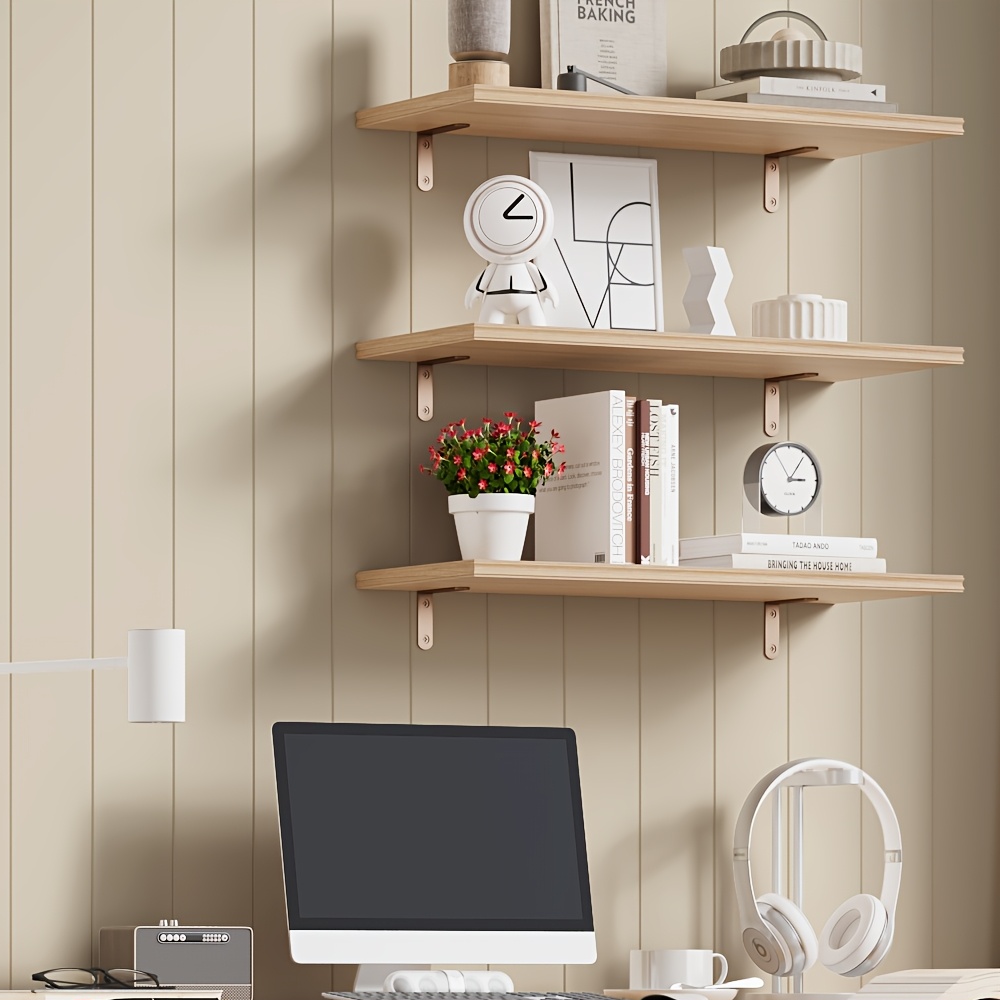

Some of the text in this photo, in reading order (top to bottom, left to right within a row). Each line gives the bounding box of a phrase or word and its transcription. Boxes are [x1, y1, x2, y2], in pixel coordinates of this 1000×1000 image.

[577, 6, 636, 24] BAKING
[806, 85, 836, 93] KINFOLK
[649, 405, 660, 442] LOST
[611, 395, 624, 556] ALEXEY BRODOVITCH
[626, 447, 635, 522] Gardens in France
[792, 541, 830, 550] TADAO ANDO
[767, 559, 852, 572] BRINGING THE HOUSE HOME
